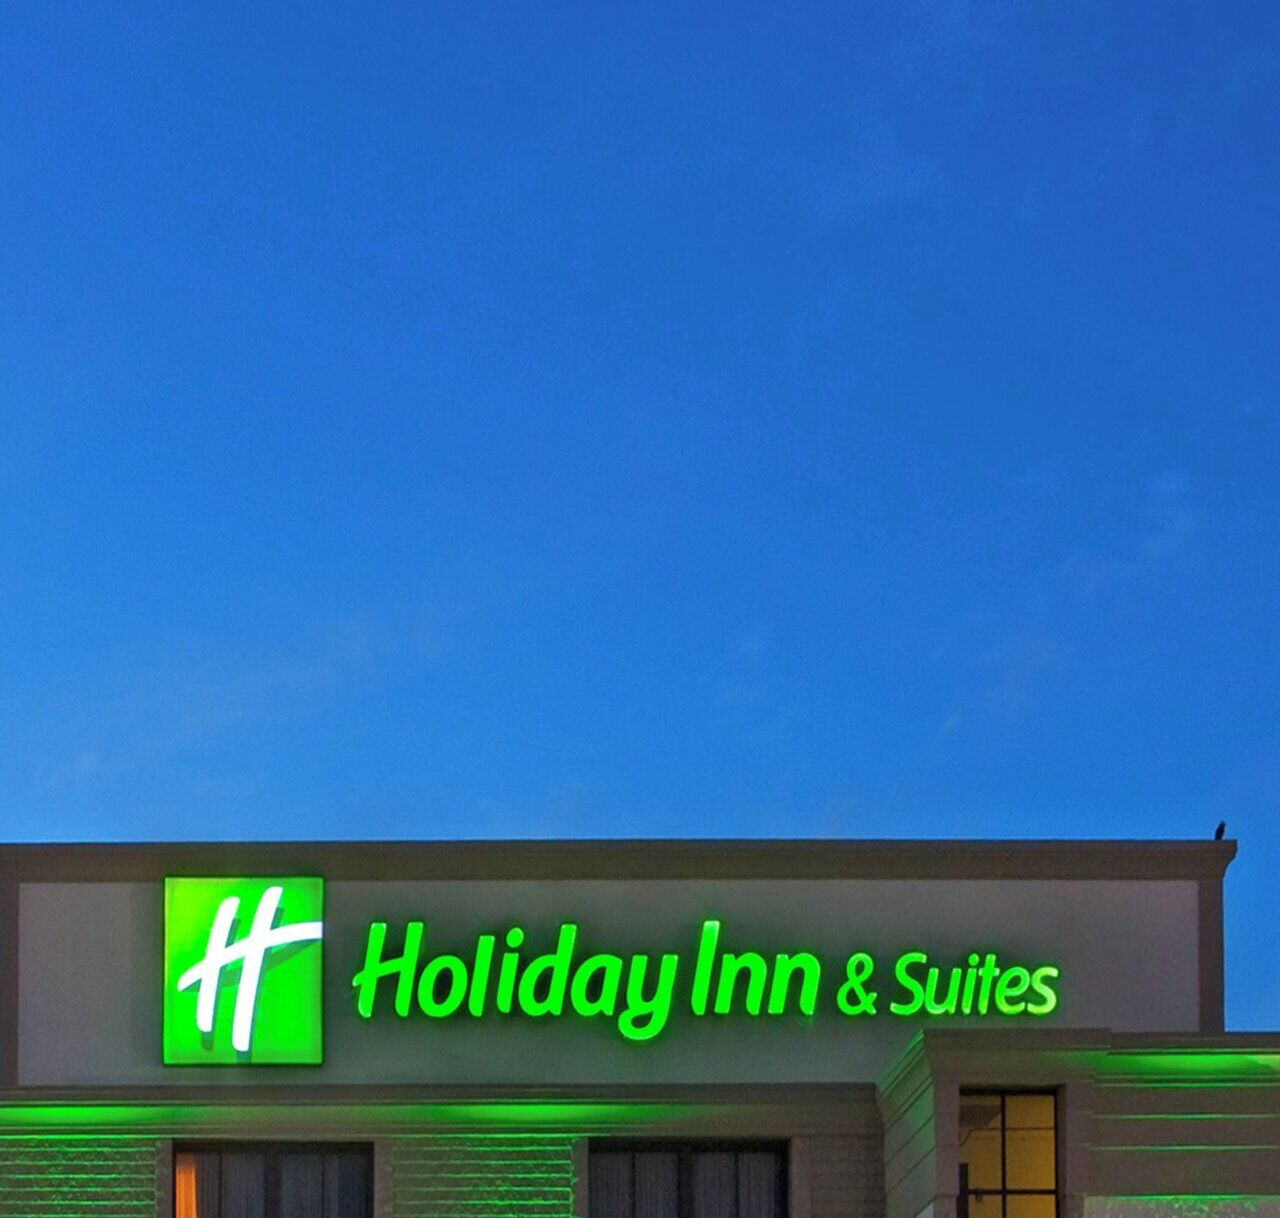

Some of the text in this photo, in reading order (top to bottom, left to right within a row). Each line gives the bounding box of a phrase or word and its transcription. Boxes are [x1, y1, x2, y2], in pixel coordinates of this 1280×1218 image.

[177, 886, 322, 1053] H
[352, 919, 1060, 1041] Holiday Inn & Suites
